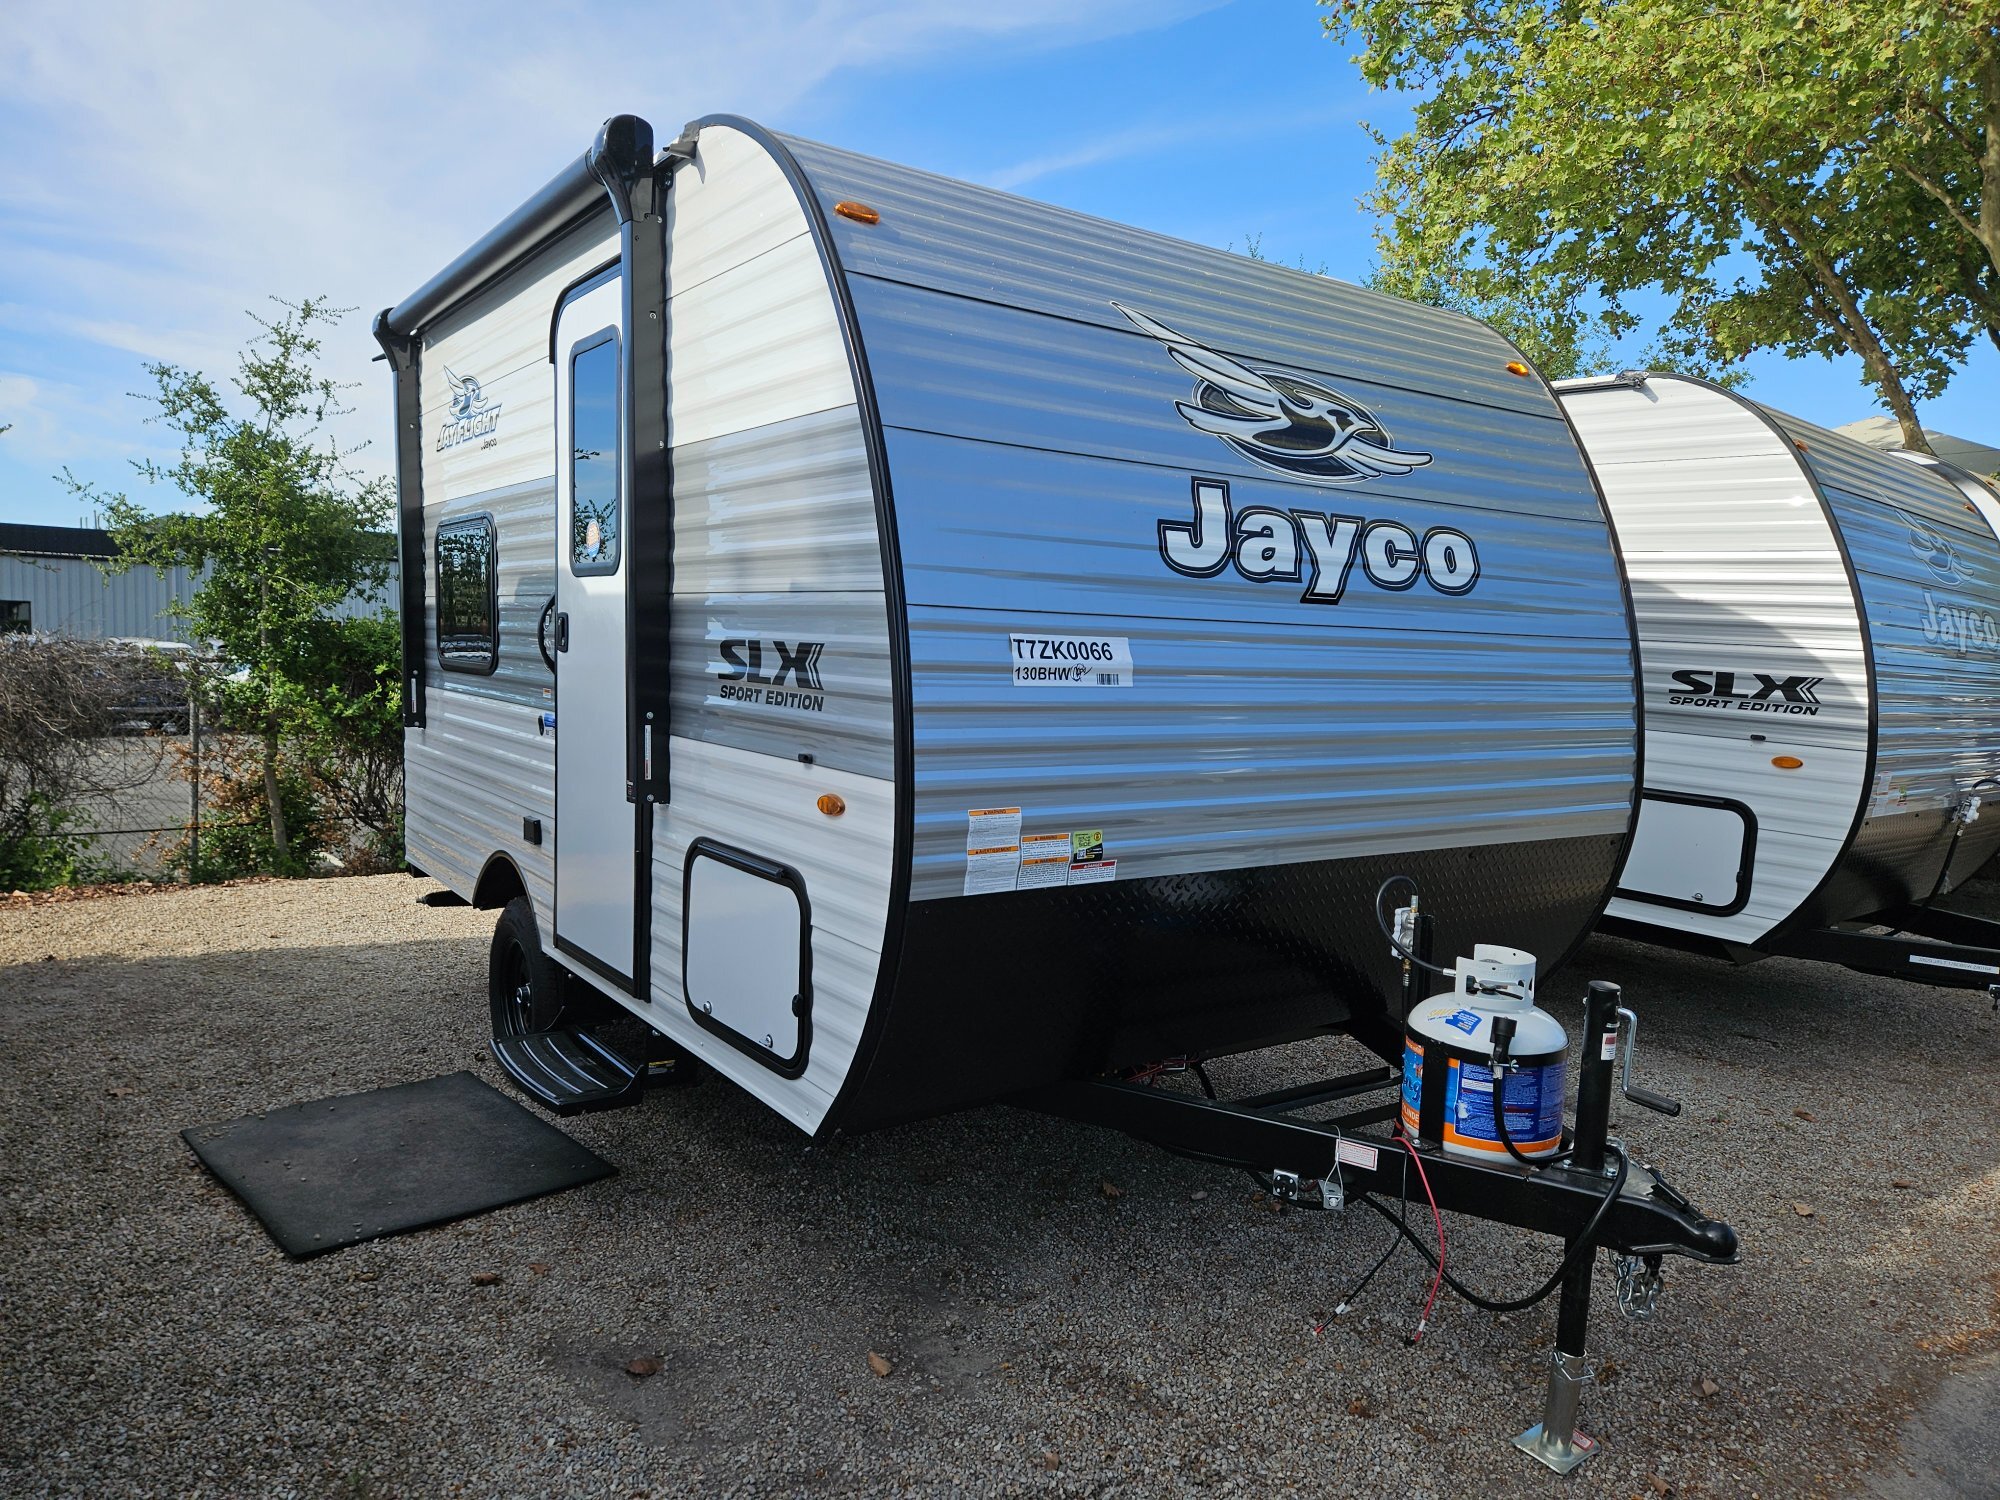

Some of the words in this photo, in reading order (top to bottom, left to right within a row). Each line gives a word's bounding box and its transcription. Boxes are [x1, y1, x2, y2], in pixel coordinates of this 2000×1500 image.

[1157, 475, 1481, 606] Jayco
[1920, 587, 2000, 656] Jayco
[717, 639, 825, 691] SLX
[1012, 638, 1113, 661] T7ZK0066
[1014, 666, 1071, 681] 130BHW
[1668, 669, 1825, 705] SLX
[719, 684, 762, 703] SPORT
[765, 689, 824, 712] EDITION
[1668, 696, 1733, 709] SPORT
[1737, 701, 1820, 716] EDITION
